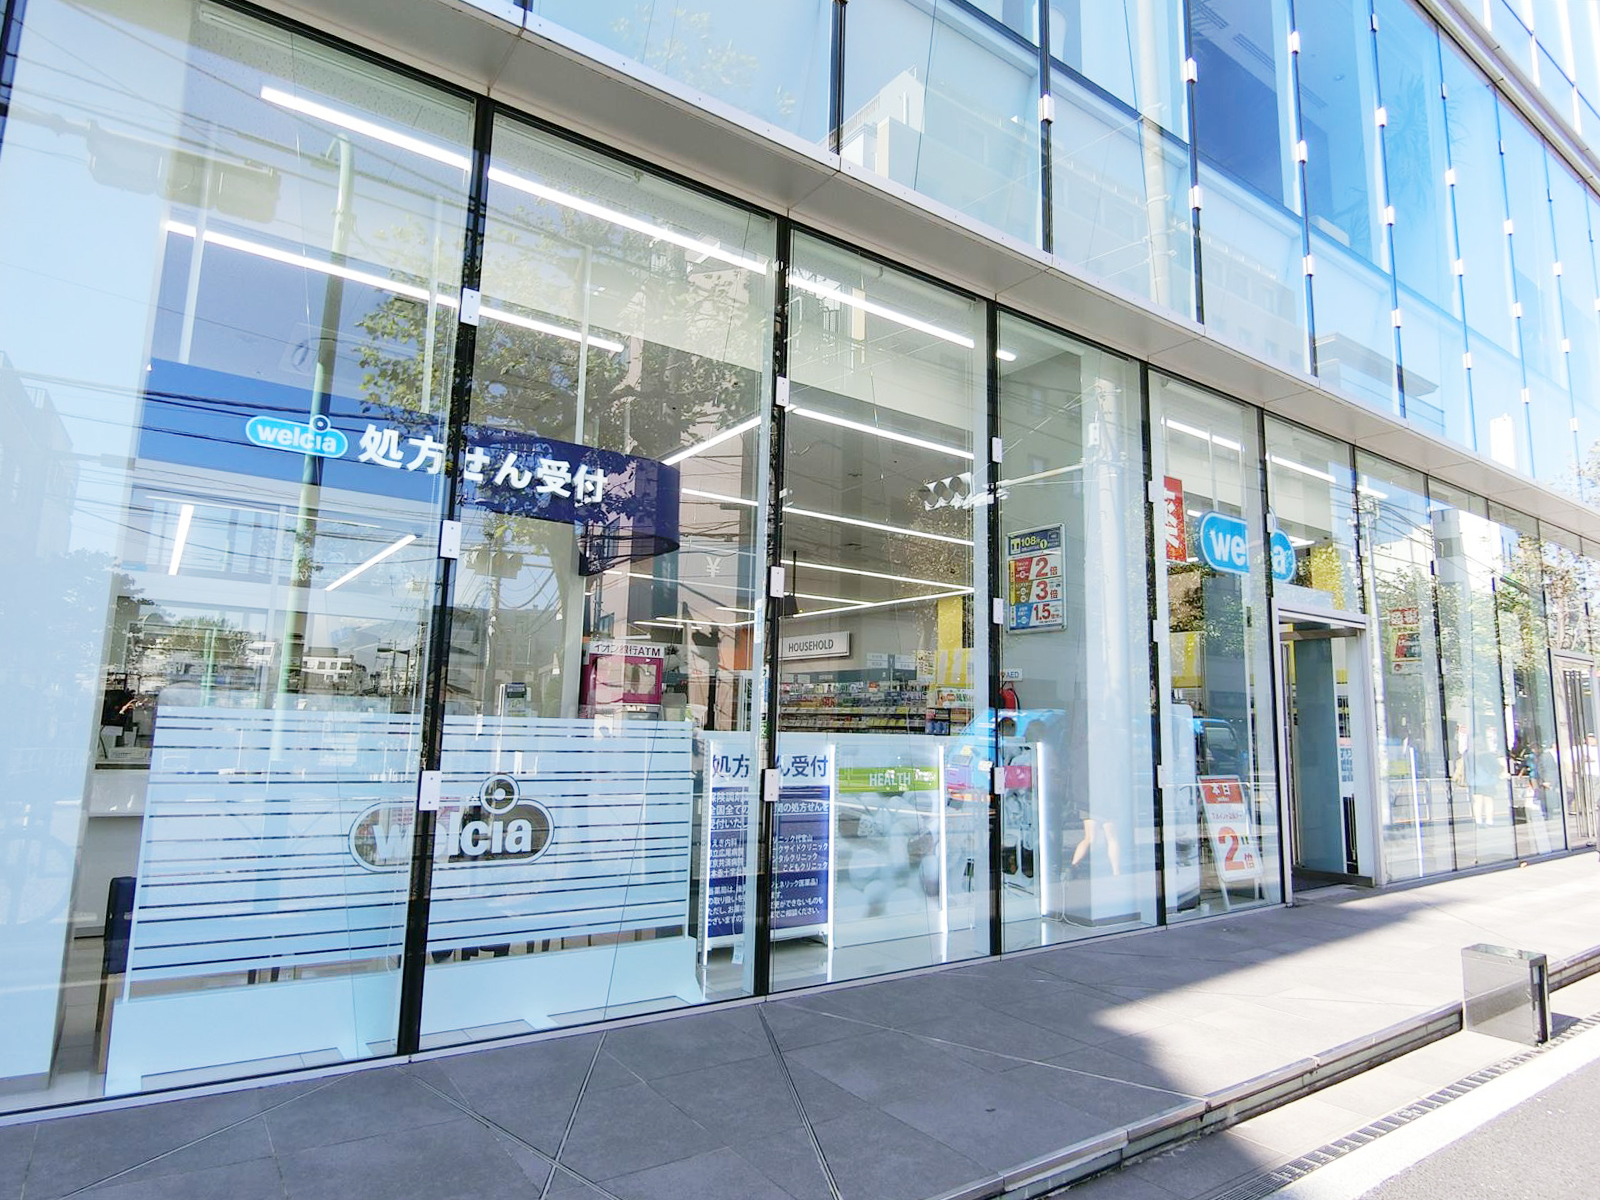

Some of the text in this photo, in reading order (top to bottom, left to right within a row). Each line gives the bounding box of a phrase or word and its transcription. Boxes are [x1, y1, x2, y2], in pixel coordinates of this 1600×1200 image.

[257, 424, 337, 452] welcia
[358, 423, 608, 504] 処方せん受付
[1211, 529, 1286, 575] wela
[788, 639, 834, 652] HOUSEHOLD
[712, 754, 829, 779] 処方ん受付
[869, 772, 912, 787] HEALTH
